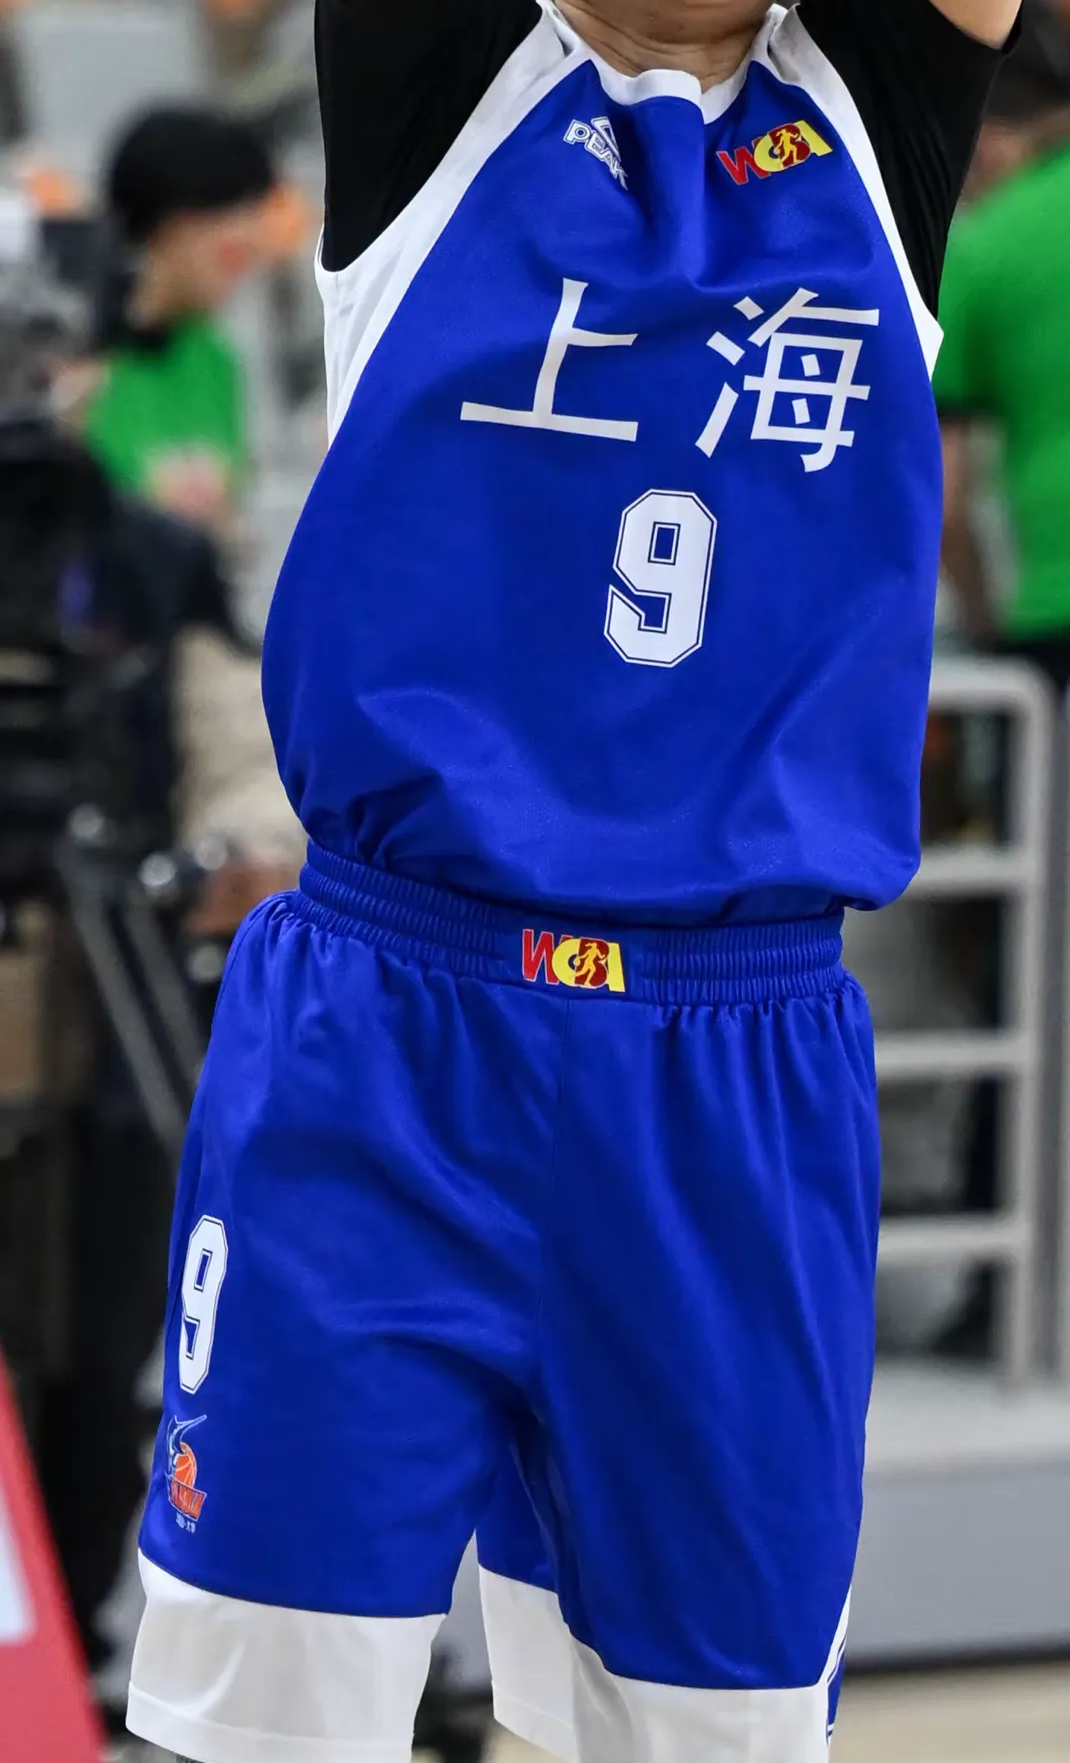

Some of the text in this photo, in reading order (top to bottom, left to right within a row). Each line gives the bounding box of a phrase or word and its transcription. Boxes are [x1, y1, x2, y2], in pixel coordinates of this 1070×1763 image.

[563, 119, 629, 190] PEAK
[717, 119, 832, 186] WCBA
[460, 277, 880, 473] 上海
[604, 488, 718, 668] 9
[520, 928, 626, 994] WCBA
[178, 1214, 229, 1395] 9
